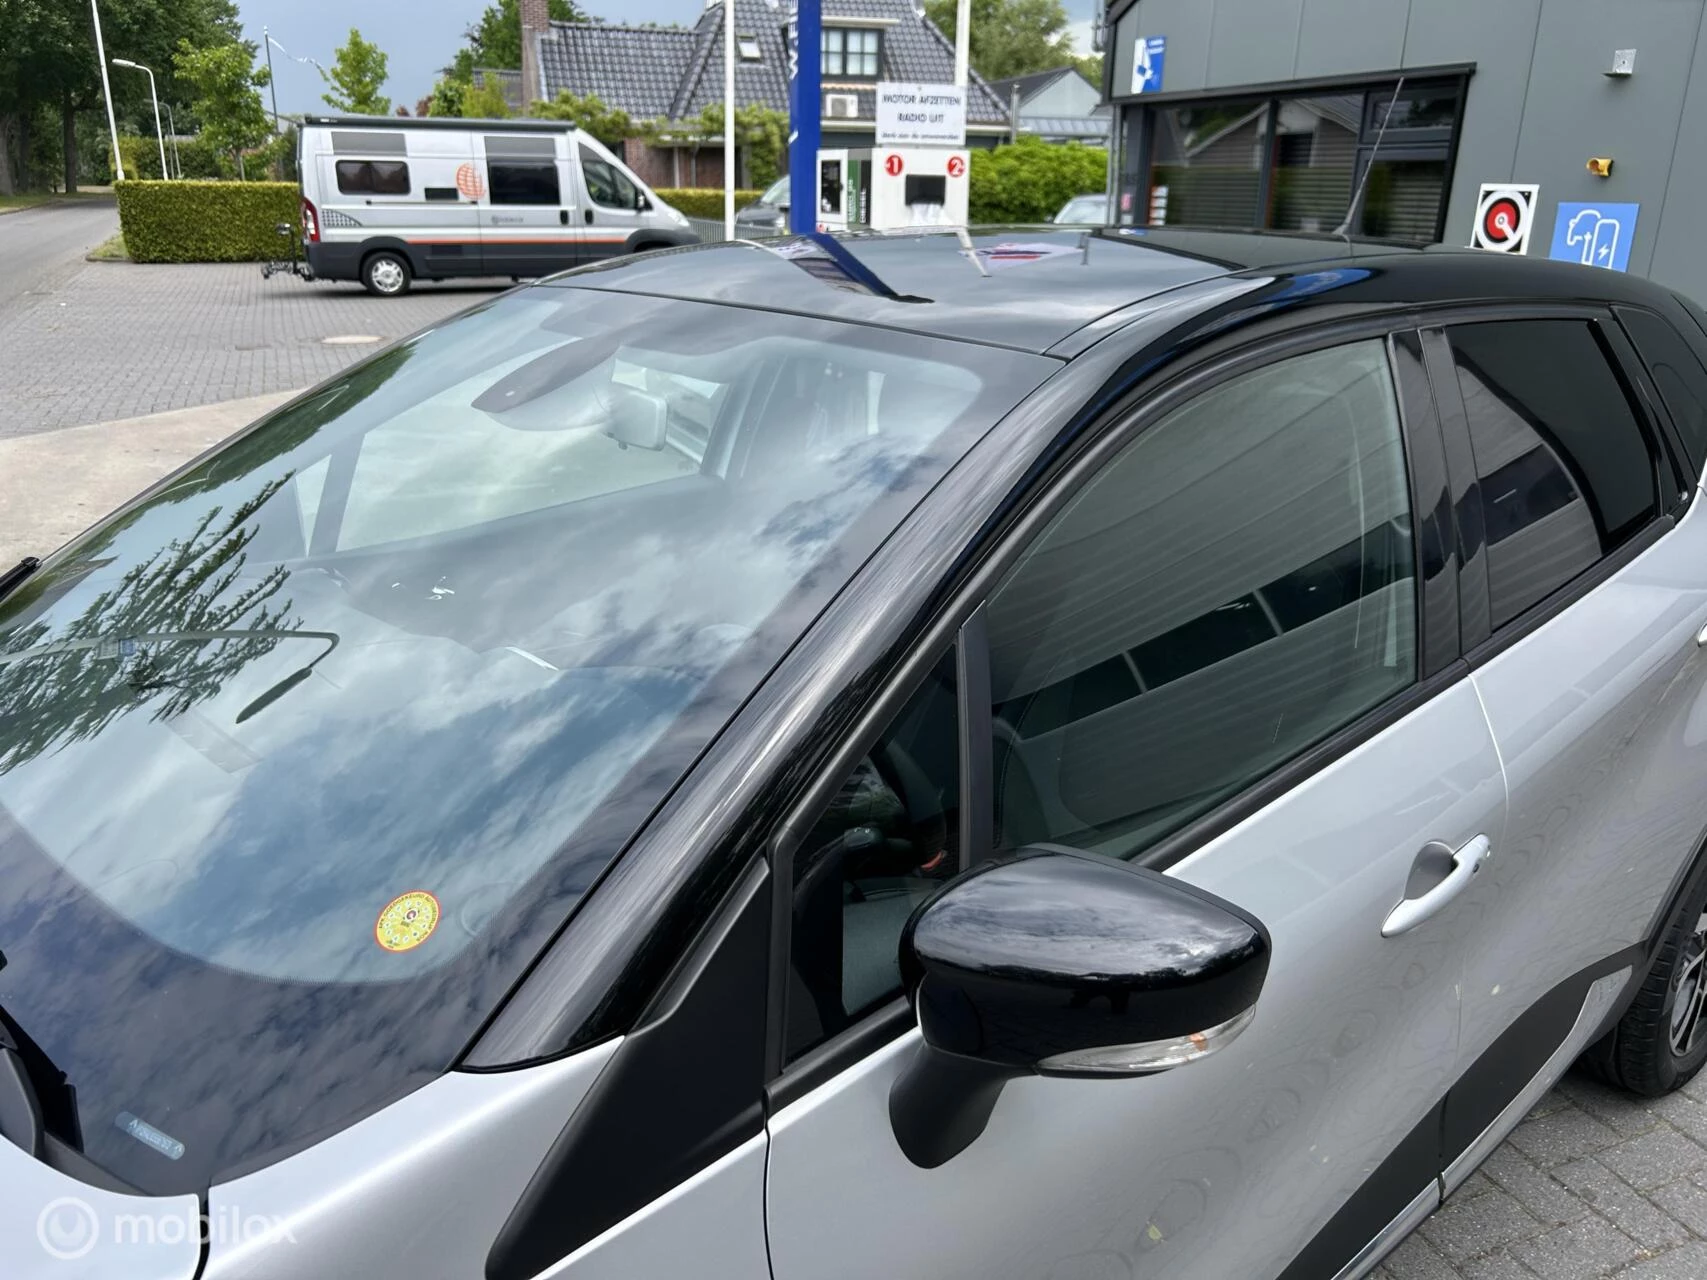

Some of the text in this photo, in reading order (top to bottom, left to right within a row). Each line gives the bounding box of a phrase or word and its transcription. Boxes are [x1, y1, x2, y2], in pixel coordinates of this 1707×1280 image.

[882, 94, 960, 105] MOTOR AFZETTEN
[898, 113, 944, 123] RADIO UIT
